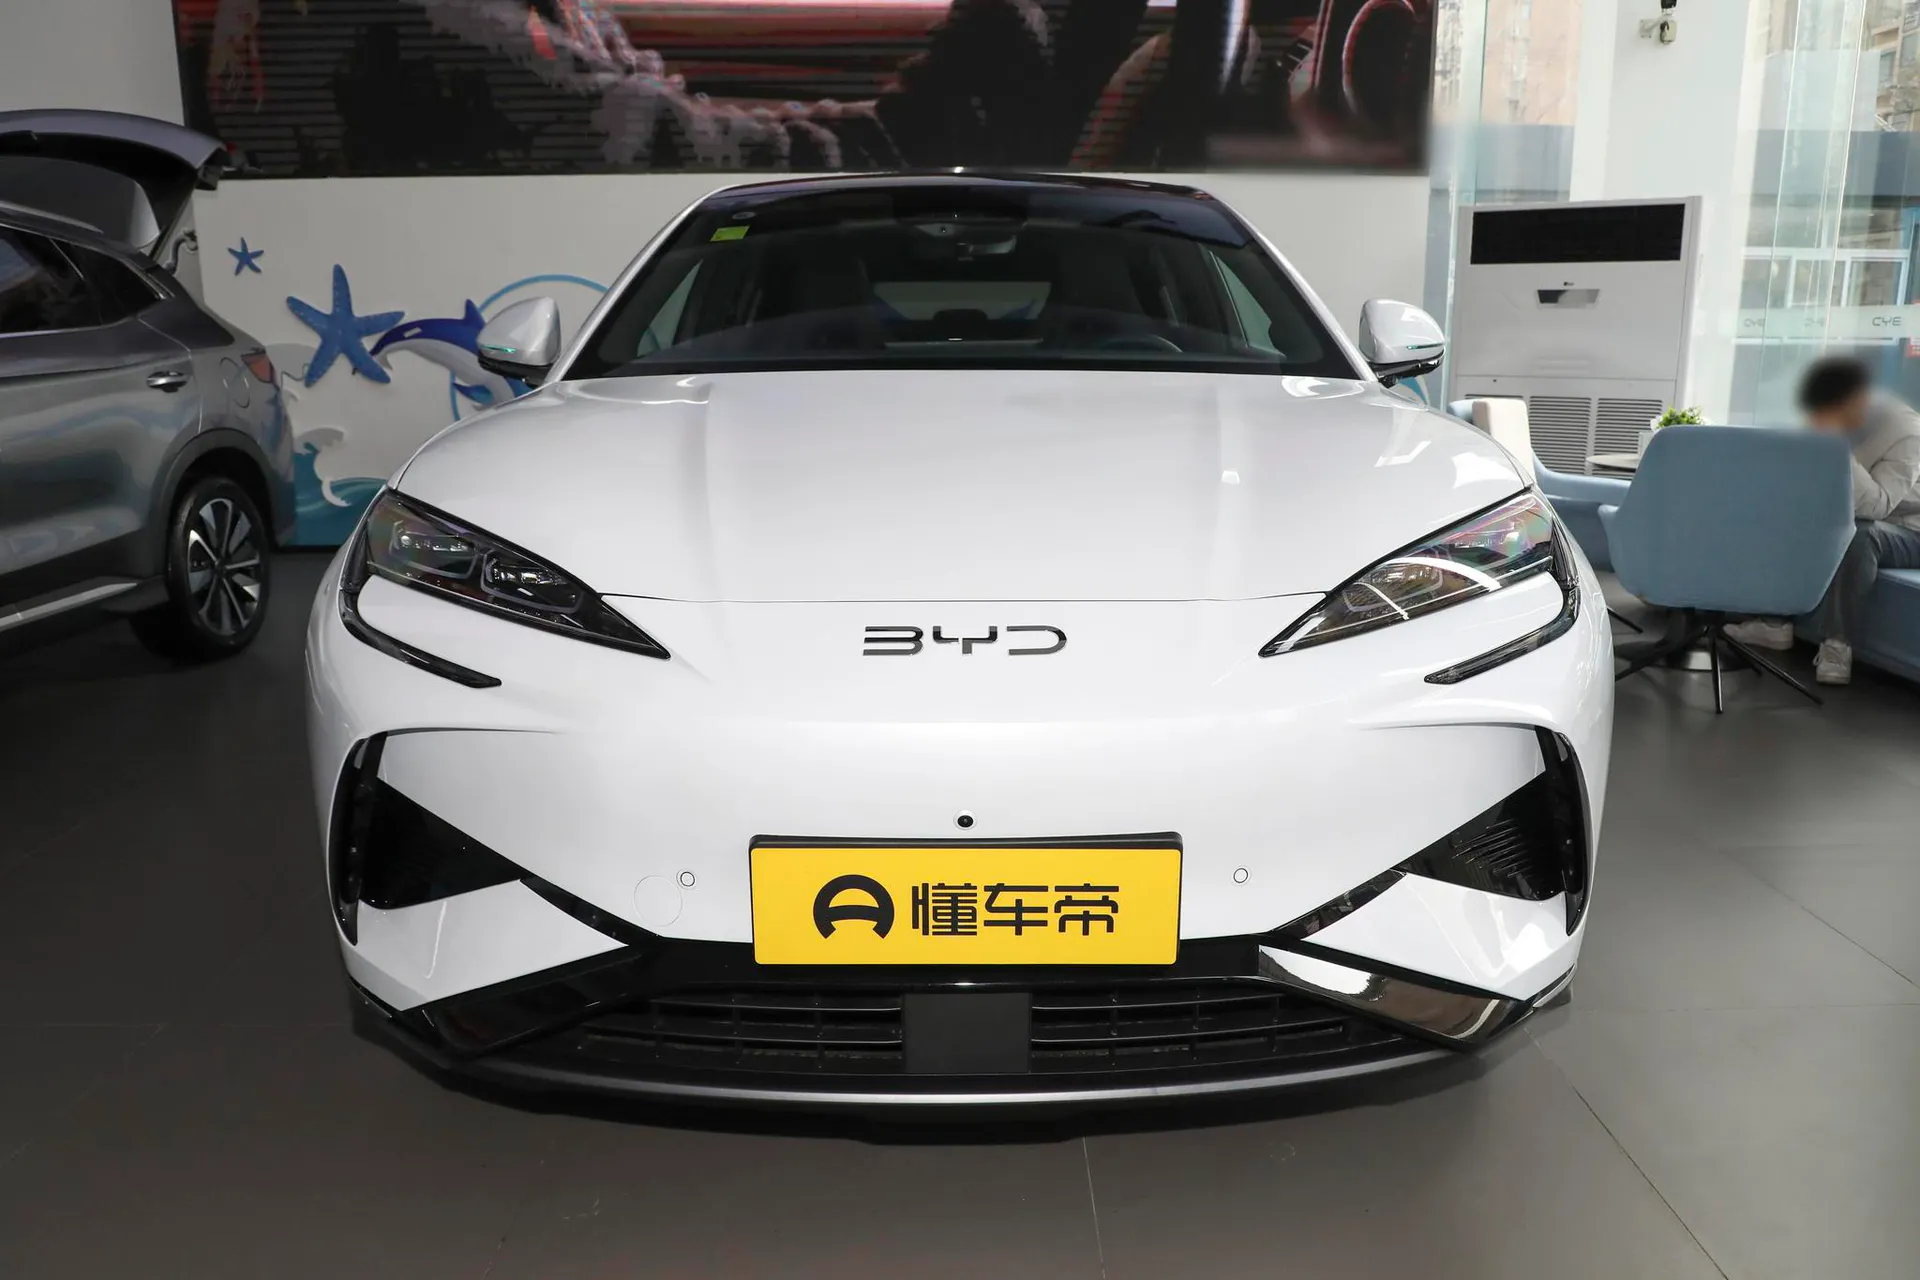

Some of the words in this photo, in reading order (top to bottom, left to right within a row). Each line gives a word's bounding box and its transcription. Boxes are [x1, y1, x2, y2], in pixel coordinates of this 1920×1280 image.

[863, 625, 1068, 656] BYD
[912, 882, 1120, 936] 懂车帝
